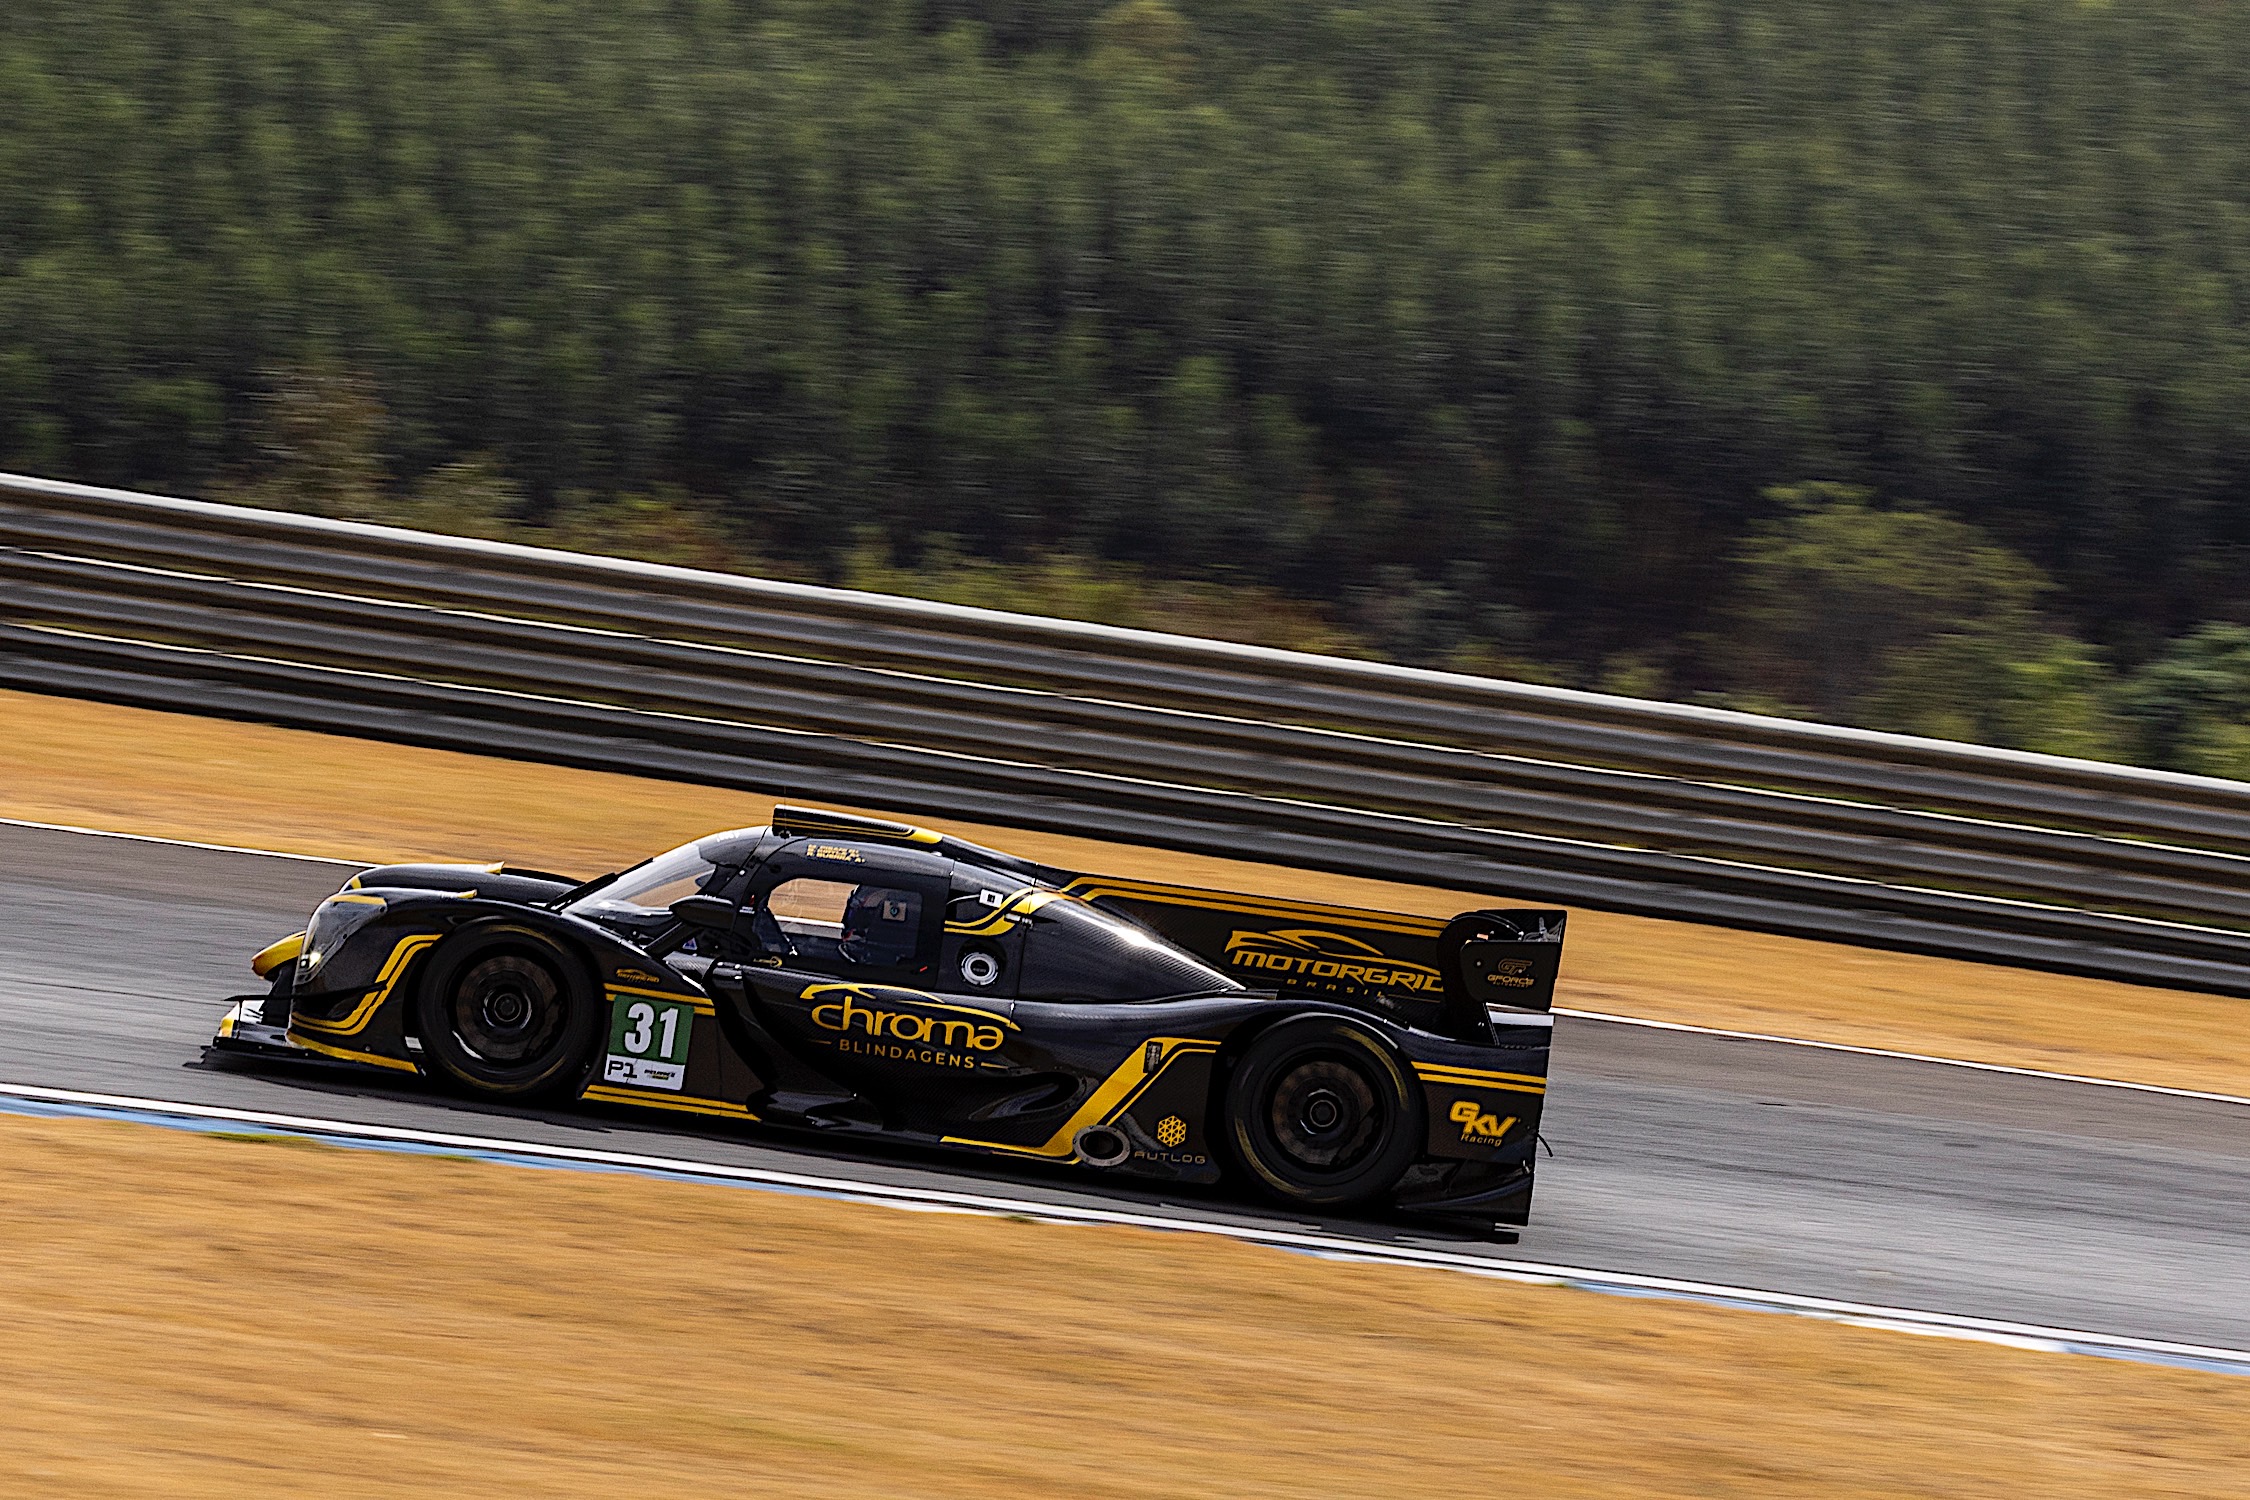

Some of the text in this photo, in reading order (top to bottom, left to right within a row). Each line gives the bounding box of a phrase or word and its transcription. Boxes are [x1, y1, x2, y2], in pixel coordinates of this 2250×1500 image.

[624, 1002, 679, 1059] 31
[811, 996, 1004, 1051] chroma
[839, 1039, 975, 1069] BLINDAGENS
[607, 1060, 638, 1079] P1
[1449, 1101, 1517, 1137] GKV
[1460, 1133, 1503, 1147] Racing
[1134, 1151, 1206, 1164] AUTLOG
